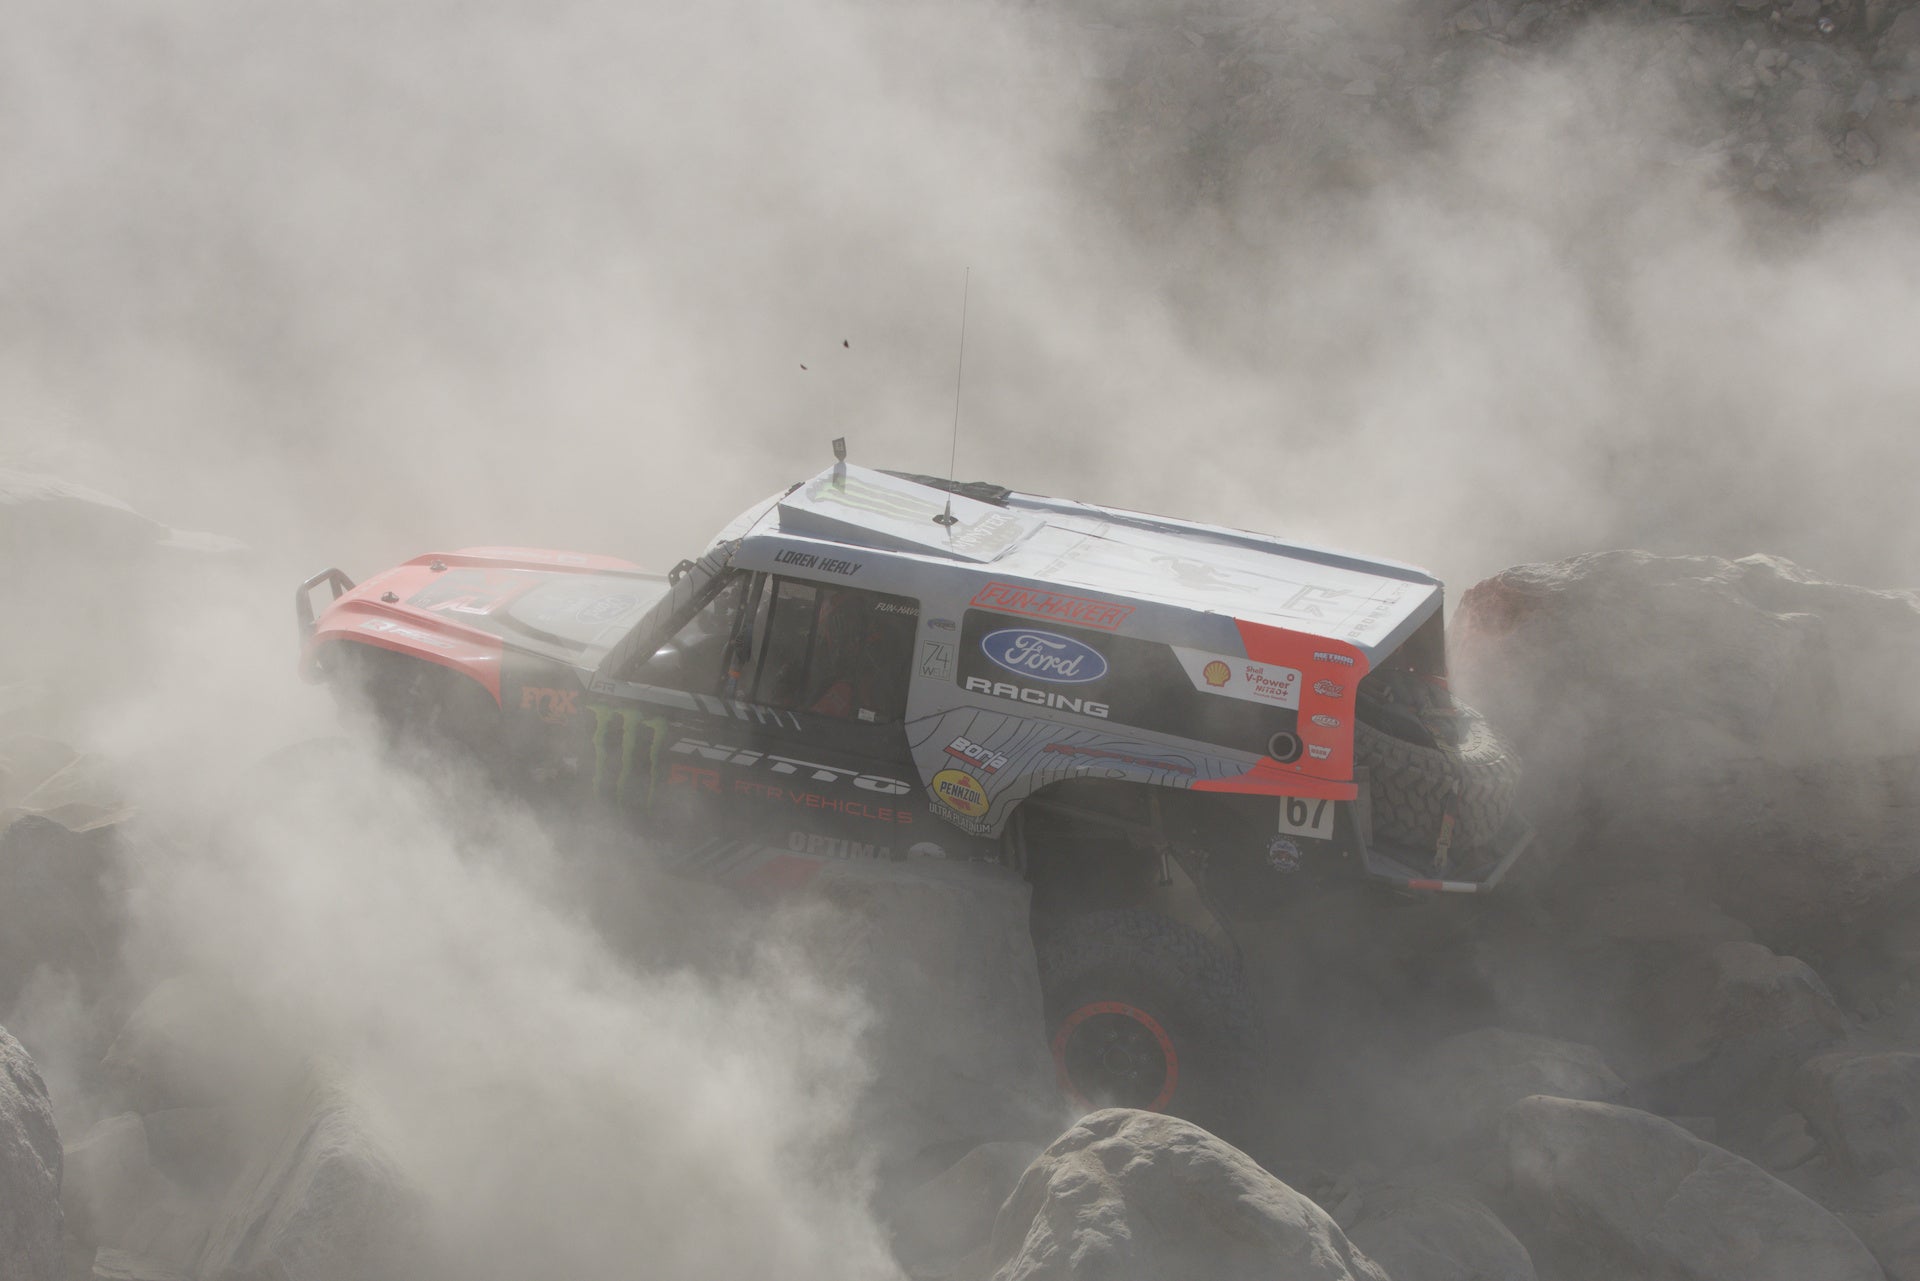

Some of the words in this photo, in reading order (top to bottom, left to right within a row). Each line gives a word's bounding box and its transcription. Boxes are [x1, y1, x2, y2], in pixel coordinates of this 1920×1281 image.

[774, 549, 820, 569] LOREN
[818, 558, 863, 576] HEALY
[980, 586, 1121, 625] FUN-HAVER
[923, 642, 949, 669] 74
[1004, 634, 1085, 677] Ford
[1246, 665, 1264, 676] Shell
[1245, 673, 1291, 690] V-Power
[520, 685, 579, 715] FOX
[965, 676, 1109, 718] RACING
[669, 736, 912, 796] NITTO
[734, 778, 785, 799] RTR
[788, 789, 914, 825] VEHICLES
[940, 780, 983, 806] PENNZOIL
